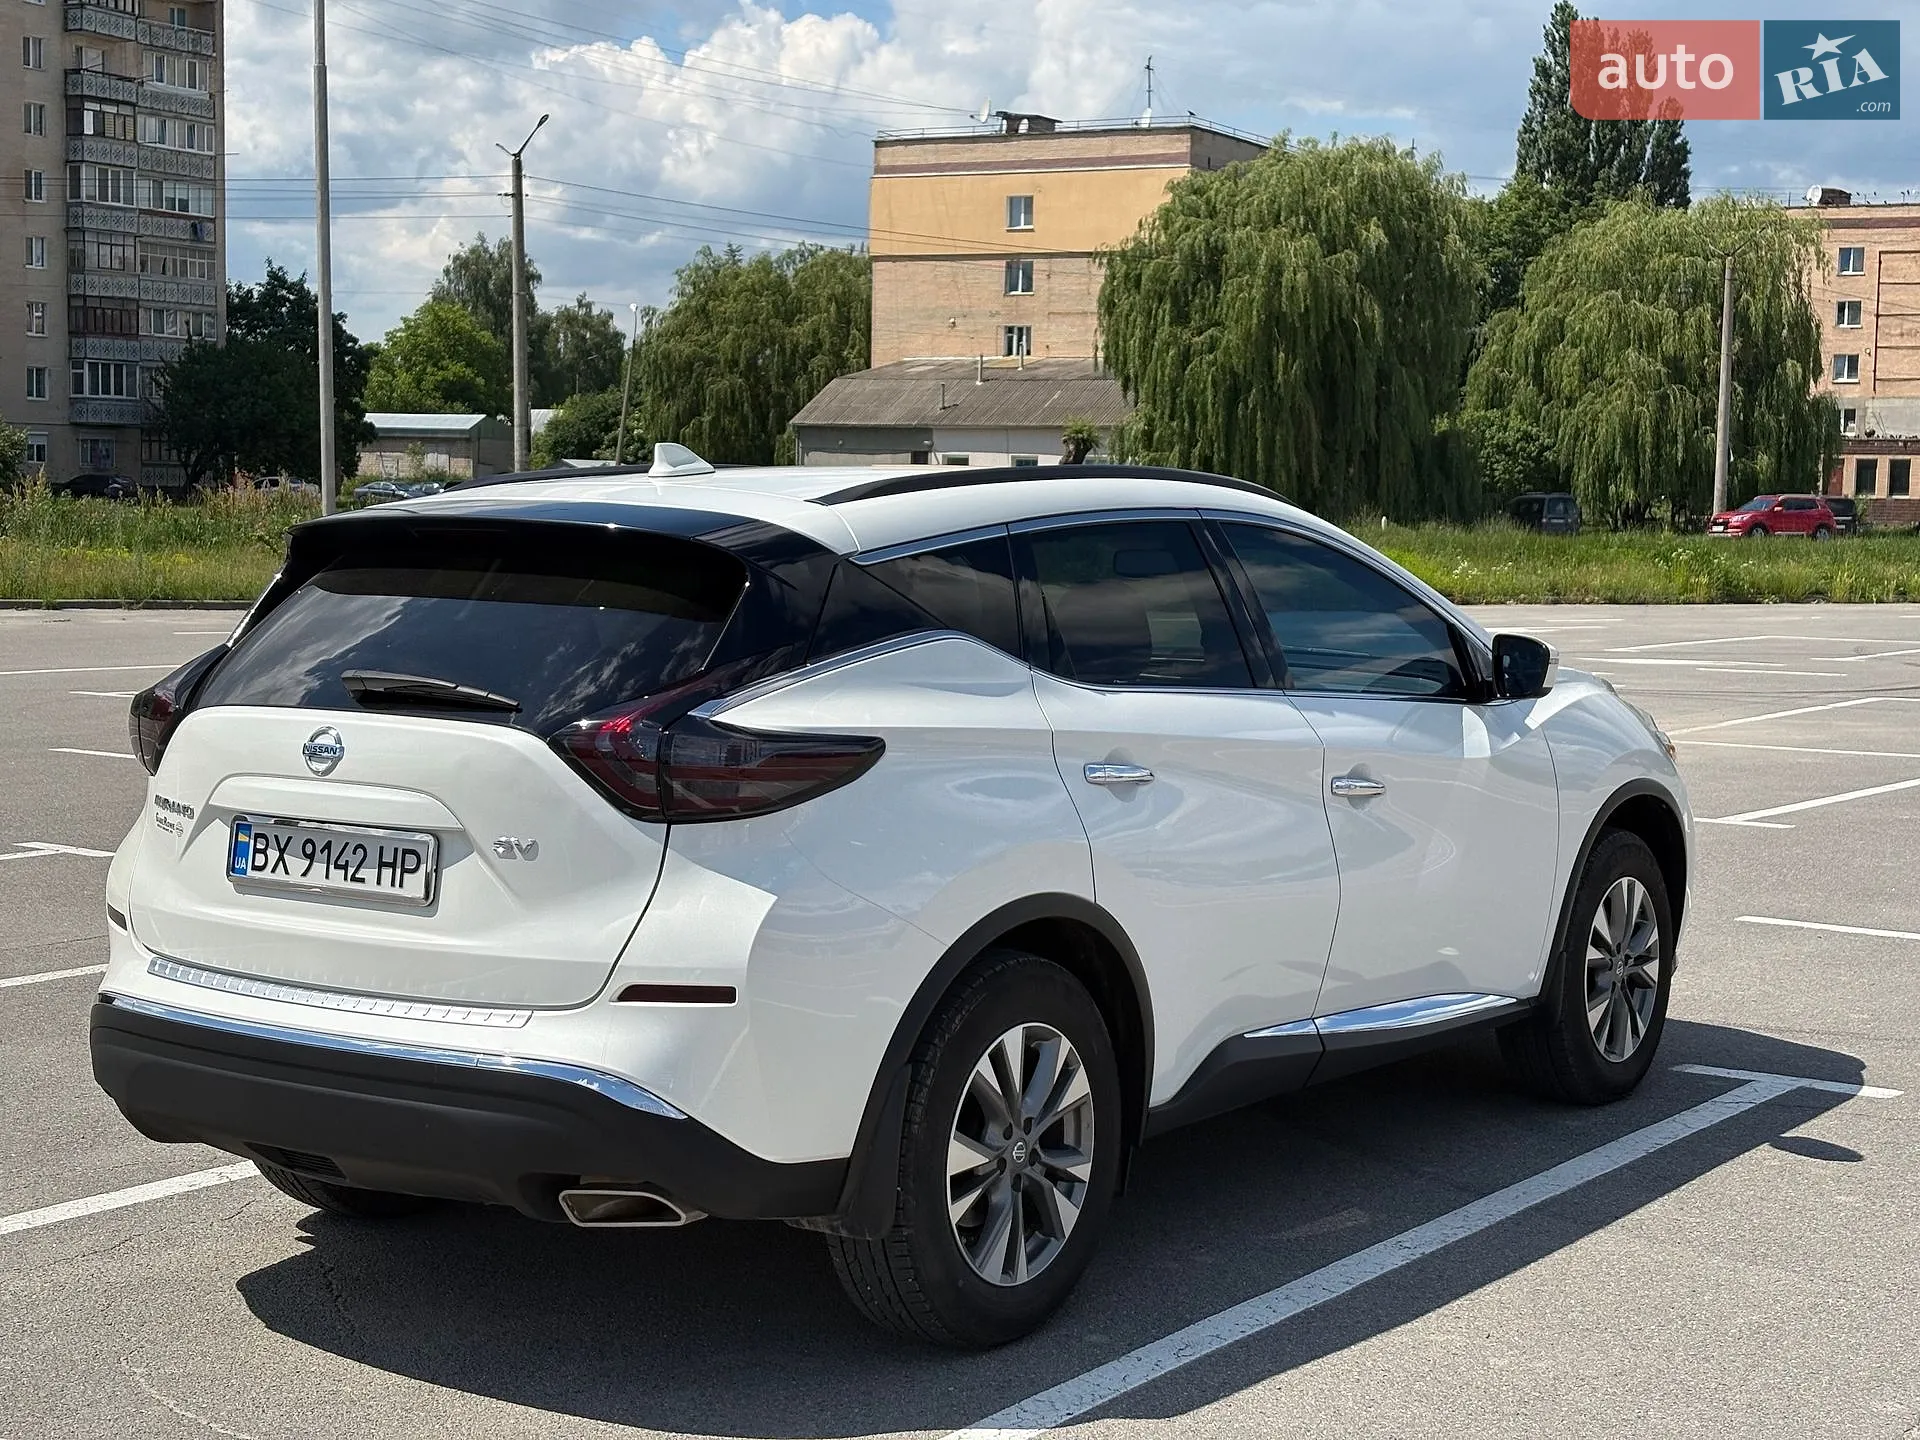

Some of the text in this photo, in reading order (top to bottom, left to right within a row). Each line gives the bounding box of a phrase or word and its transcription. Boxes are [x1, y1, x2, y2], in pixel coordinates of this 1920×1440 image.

[305, 744, 338, 757] NISSAN
[234, 856, 247, 871] UA
[250, 832, 422, 889] BX 9142 HP
